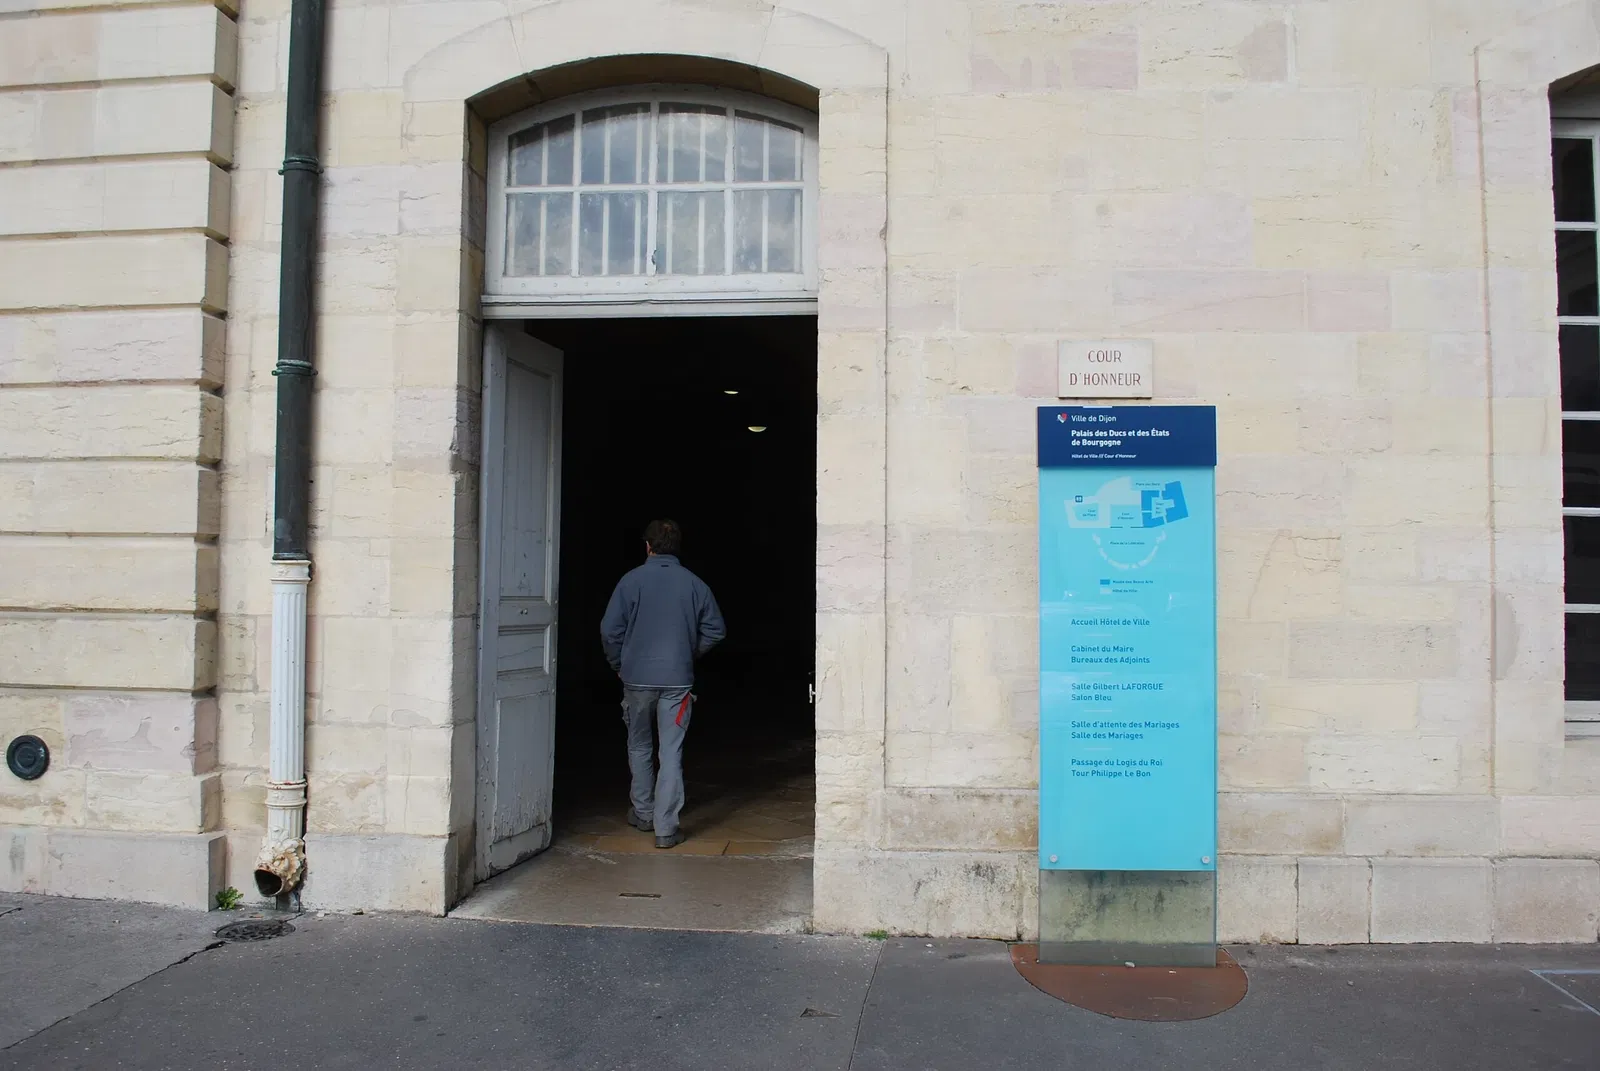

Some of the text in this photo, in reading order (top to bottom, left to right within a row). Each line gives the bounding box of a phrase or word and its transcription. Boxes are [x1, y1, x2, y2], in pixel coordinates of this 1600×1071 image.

[1088, 350, 1122, 363] COUR
[1069, 372, 1141, 386] D'HONNEUR
[1071, 414, 1117, 423] Ville de Dijon
[1071, 428, 1170, 437] Palais des Ducs et des États
[1071, 438, 1121, 447] de Bourgogne
[1071, 618, 1150, 626] Accueil Hôtel de Ville
[1071, 645, 1134, 653] Cabinet du Maire
[1119, 656, 1150, 665] Adjoints
[1071, 682, 1164, 690] Salle Gilbert LAFORGUE
[1071, 693, 1112, 701] Salon Bleu
[1071, 720, 1180, 730] Salle d'attente des Mariages
[1071, 731, 1144, 740] Salle des Mariages
[1071, 758, 1163, 767] Passage du Logis du Roi
[1071, 769, 1151, 778] Tour Philippe Le Bon
